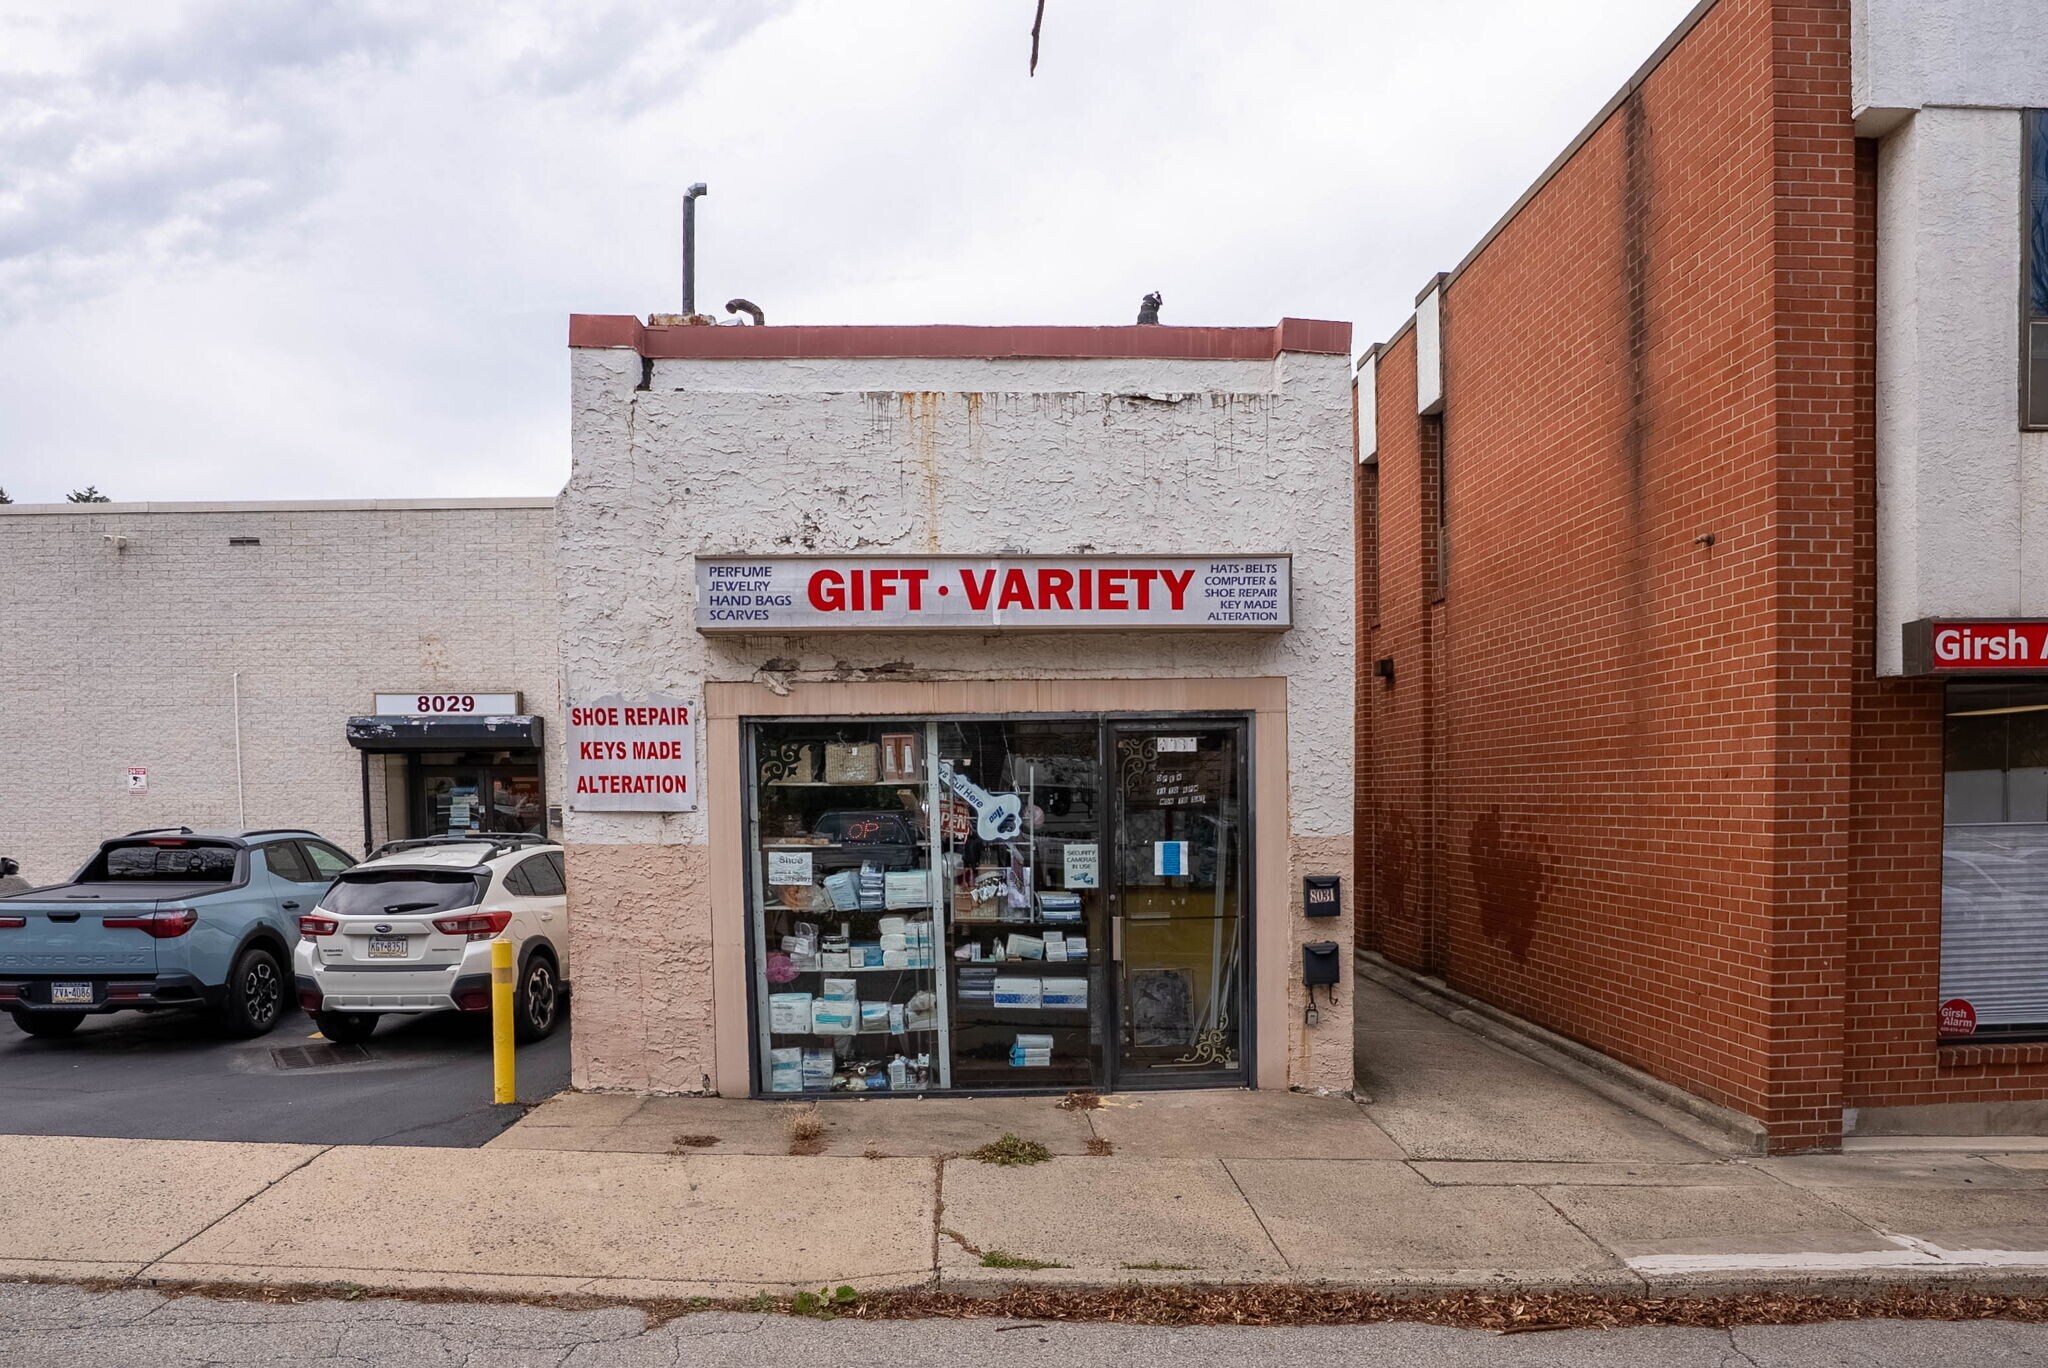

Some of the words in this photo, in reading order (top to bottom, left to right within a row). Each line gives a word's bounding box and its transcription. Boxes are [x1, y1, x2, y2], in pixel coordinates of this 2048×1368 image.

[709, 566, 772, 577] PERFUME
[709, 581, 771, 592] JEWELRY
[1204, 576, 1266, 586] COMPUTER
[1268, 576, 1277, 586] &
[808, 569, 929, 611] GIFT
[959, 569, 1196, 611] VARIETY
[1205, 588, 1236, 598] SHOE
[1238, 588, 1278, 598] REPAIR
[710, 595, 752, 606] HAND
[755, 595, 792, 606] BAGS
[1220, 600, 1241, 610] KEY
[1243, 600, 1278, 610] MADE
[709, 609, 769, 620] SCARVES
[1207, 612, 1278, 621] ALTERATION
[1935, 628, 2029, 660] Girsh
[417, 695, 475, 713] 8029
[572, 707, 618, 726] SHOE
[624, 707, 689, 726] REPAIR
[580, 741, 627, 760] KEYS
[633, 741, 681, 760] MADE
[576, 775, 687, 793] ALTERATION
[963, 786, 984, 809] Here
[988, 806, 1004, 824] ilco
[1309, 888, 1335, 903] 8031
[1941, 1007, 1967, 1018] Girsh
[1943, 1017, 1973, 1027] Alarm
